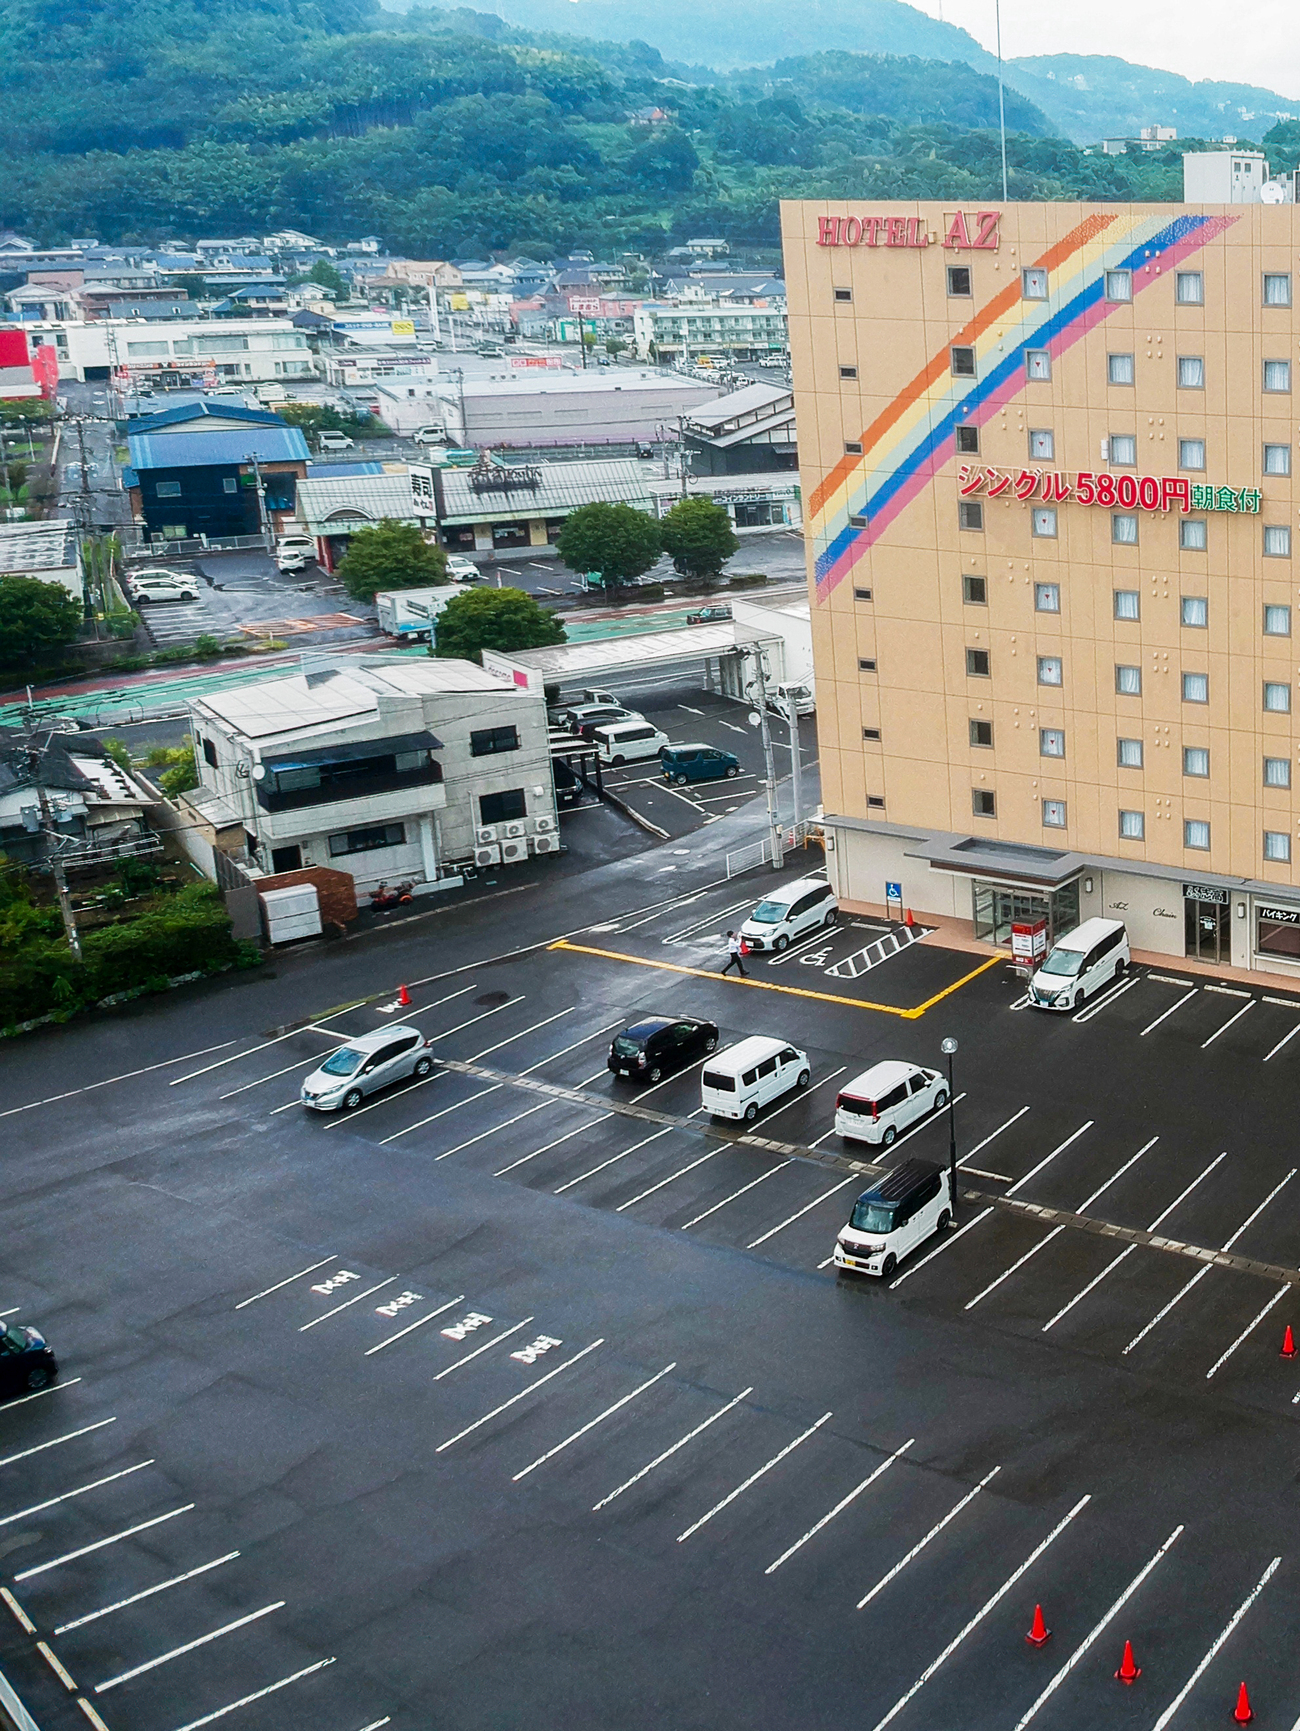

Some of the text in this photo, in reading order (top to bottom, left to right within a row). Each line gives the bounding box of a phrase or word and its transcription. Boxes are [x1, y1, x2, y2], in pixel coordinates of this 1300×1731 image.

[816, 210, 1001, 249] HOTEL AZ
[958, 464, 1262, 514] シングル 5800円 朝食付
[1262, 908, 1298, 922] バイキング
